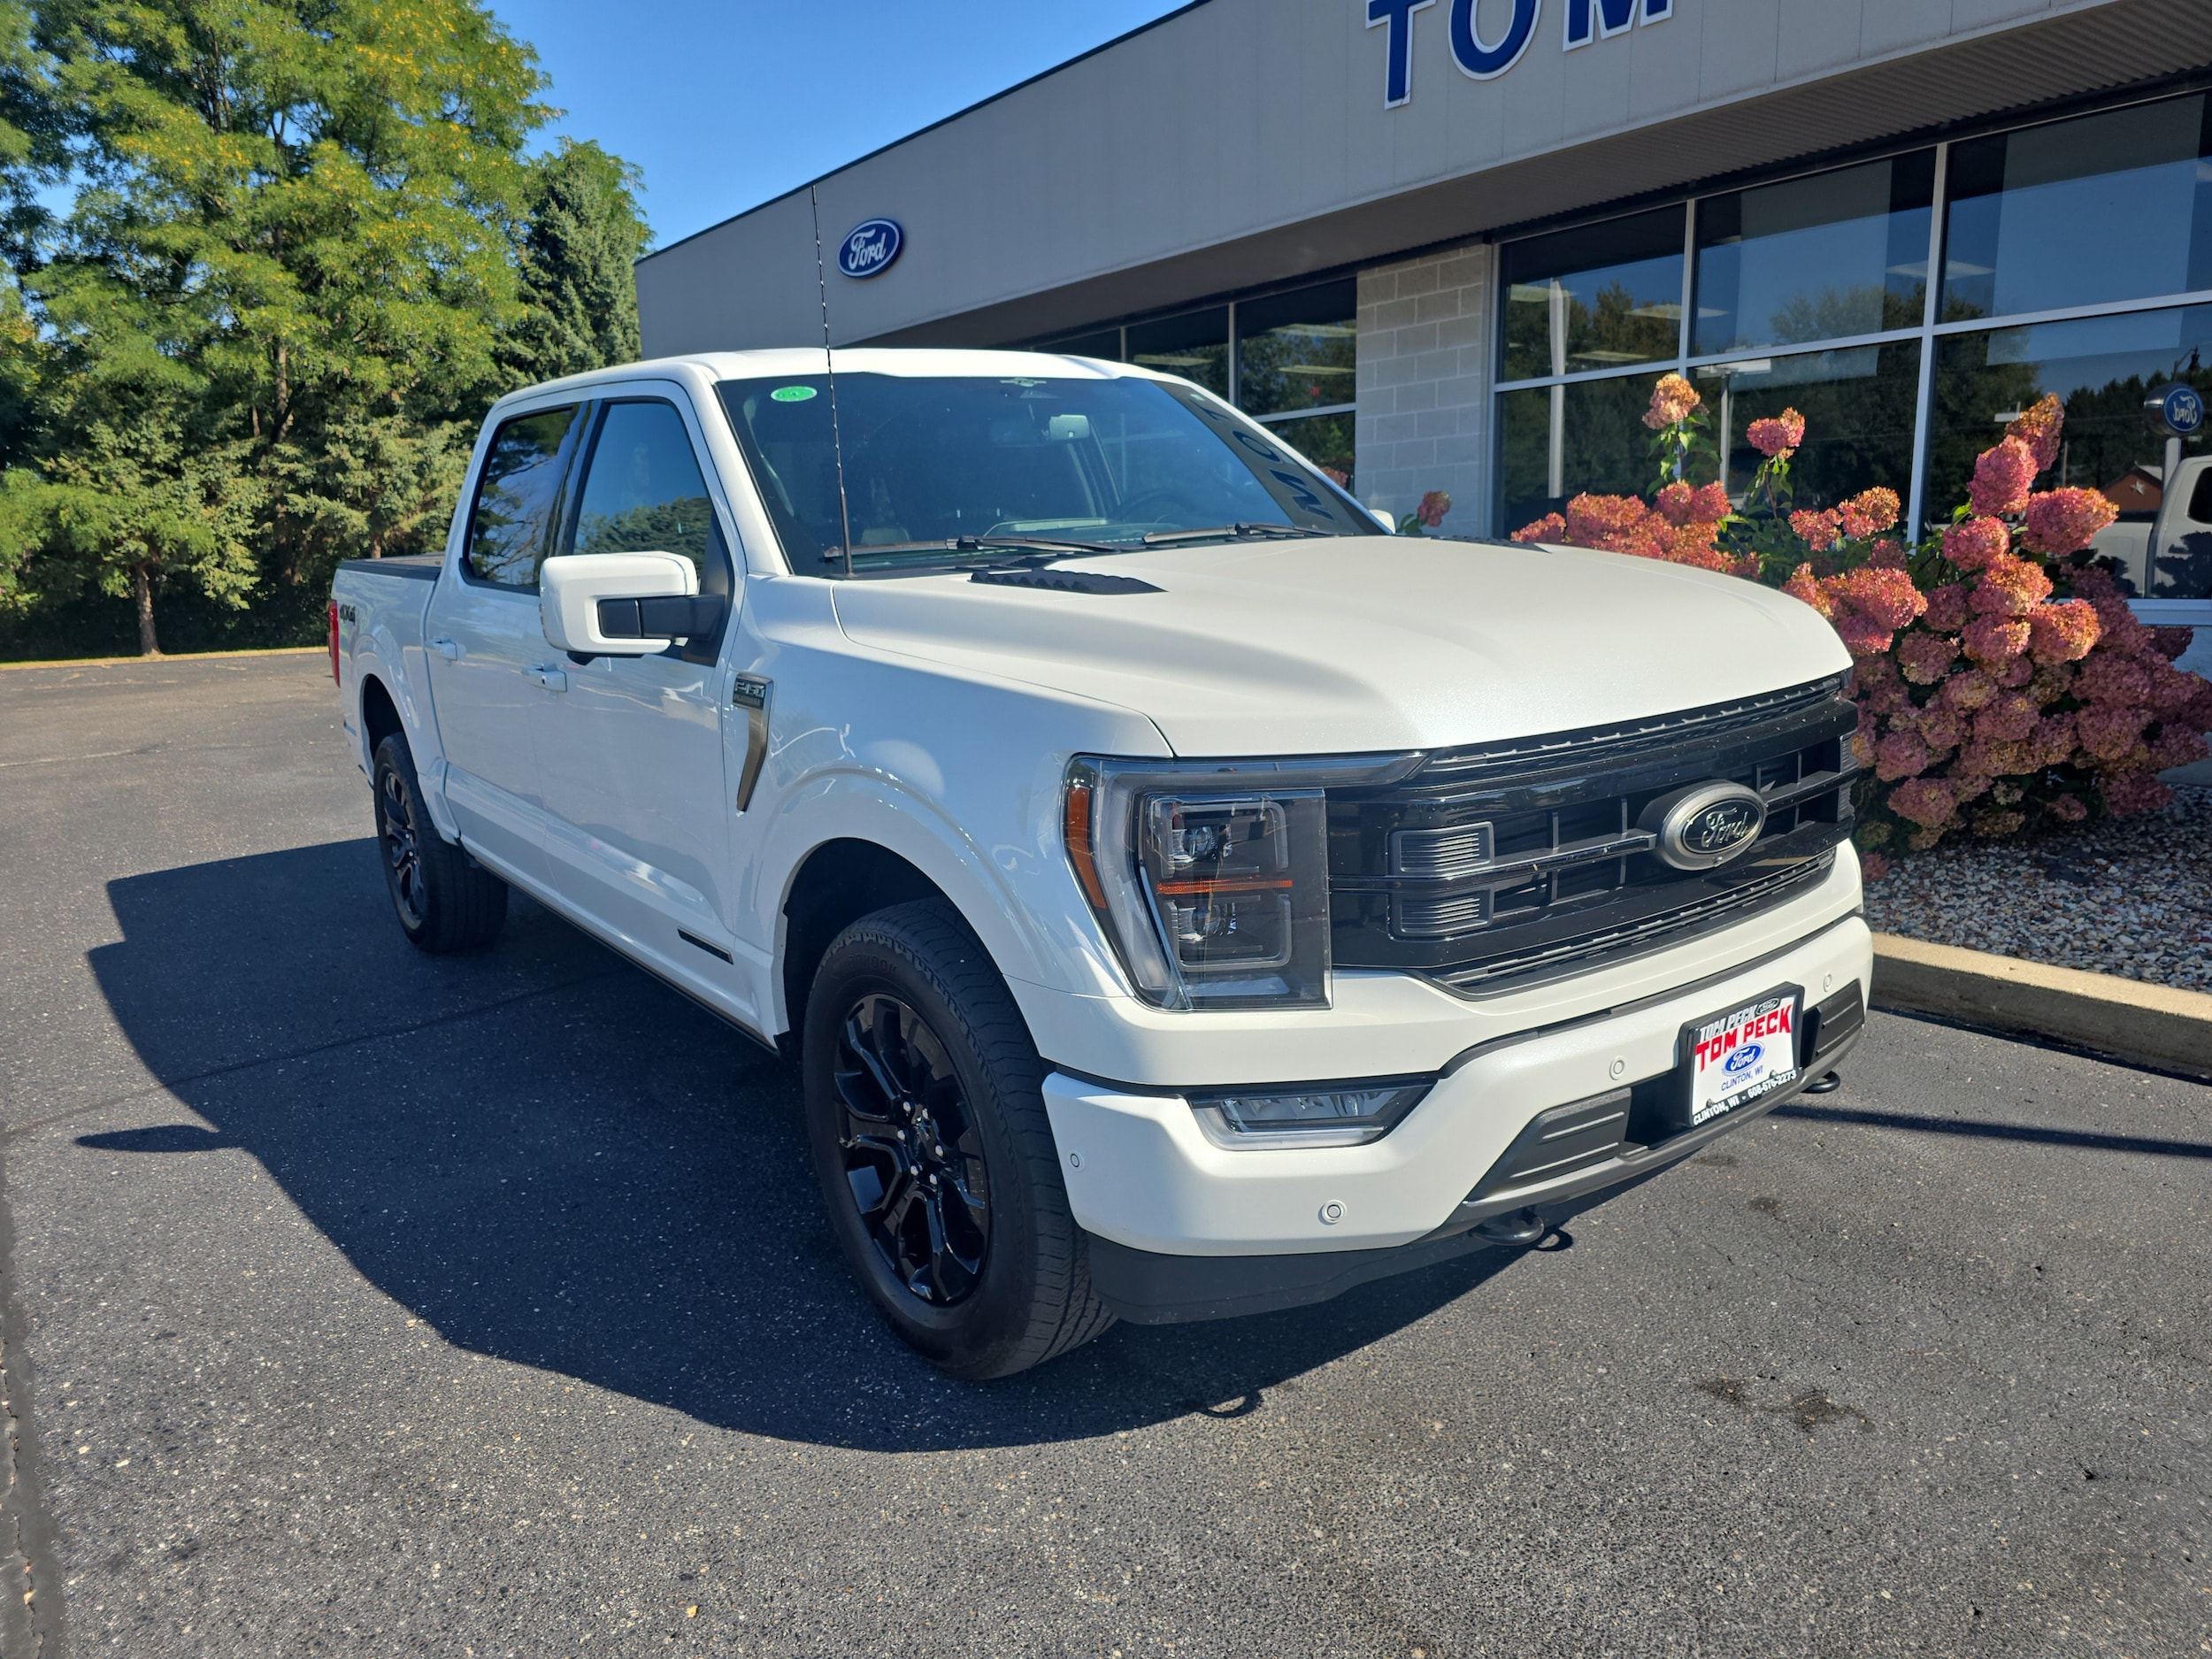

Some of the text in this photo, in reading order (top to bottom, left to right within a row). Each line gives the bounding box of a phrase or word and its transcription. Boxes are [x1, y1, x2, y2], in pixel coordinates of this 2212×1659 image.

[849, 228, 887, 270] Ford
[1701, 807, 1748, 848] Ford
[1695, 1004, 1793, 1073] TOM PECK
[1700, 1018, 1726, 1043] TOM
[1726, 1004, 1758, 1028] PECK
[1721, 1065, 1763, 1091] CLINTON, WI
[1731, 1047, 1756, 1071] Ford
[1693, 1102, 1729, 1125] CLINTON,
[1727, 1094, 1740, 1107] WI
